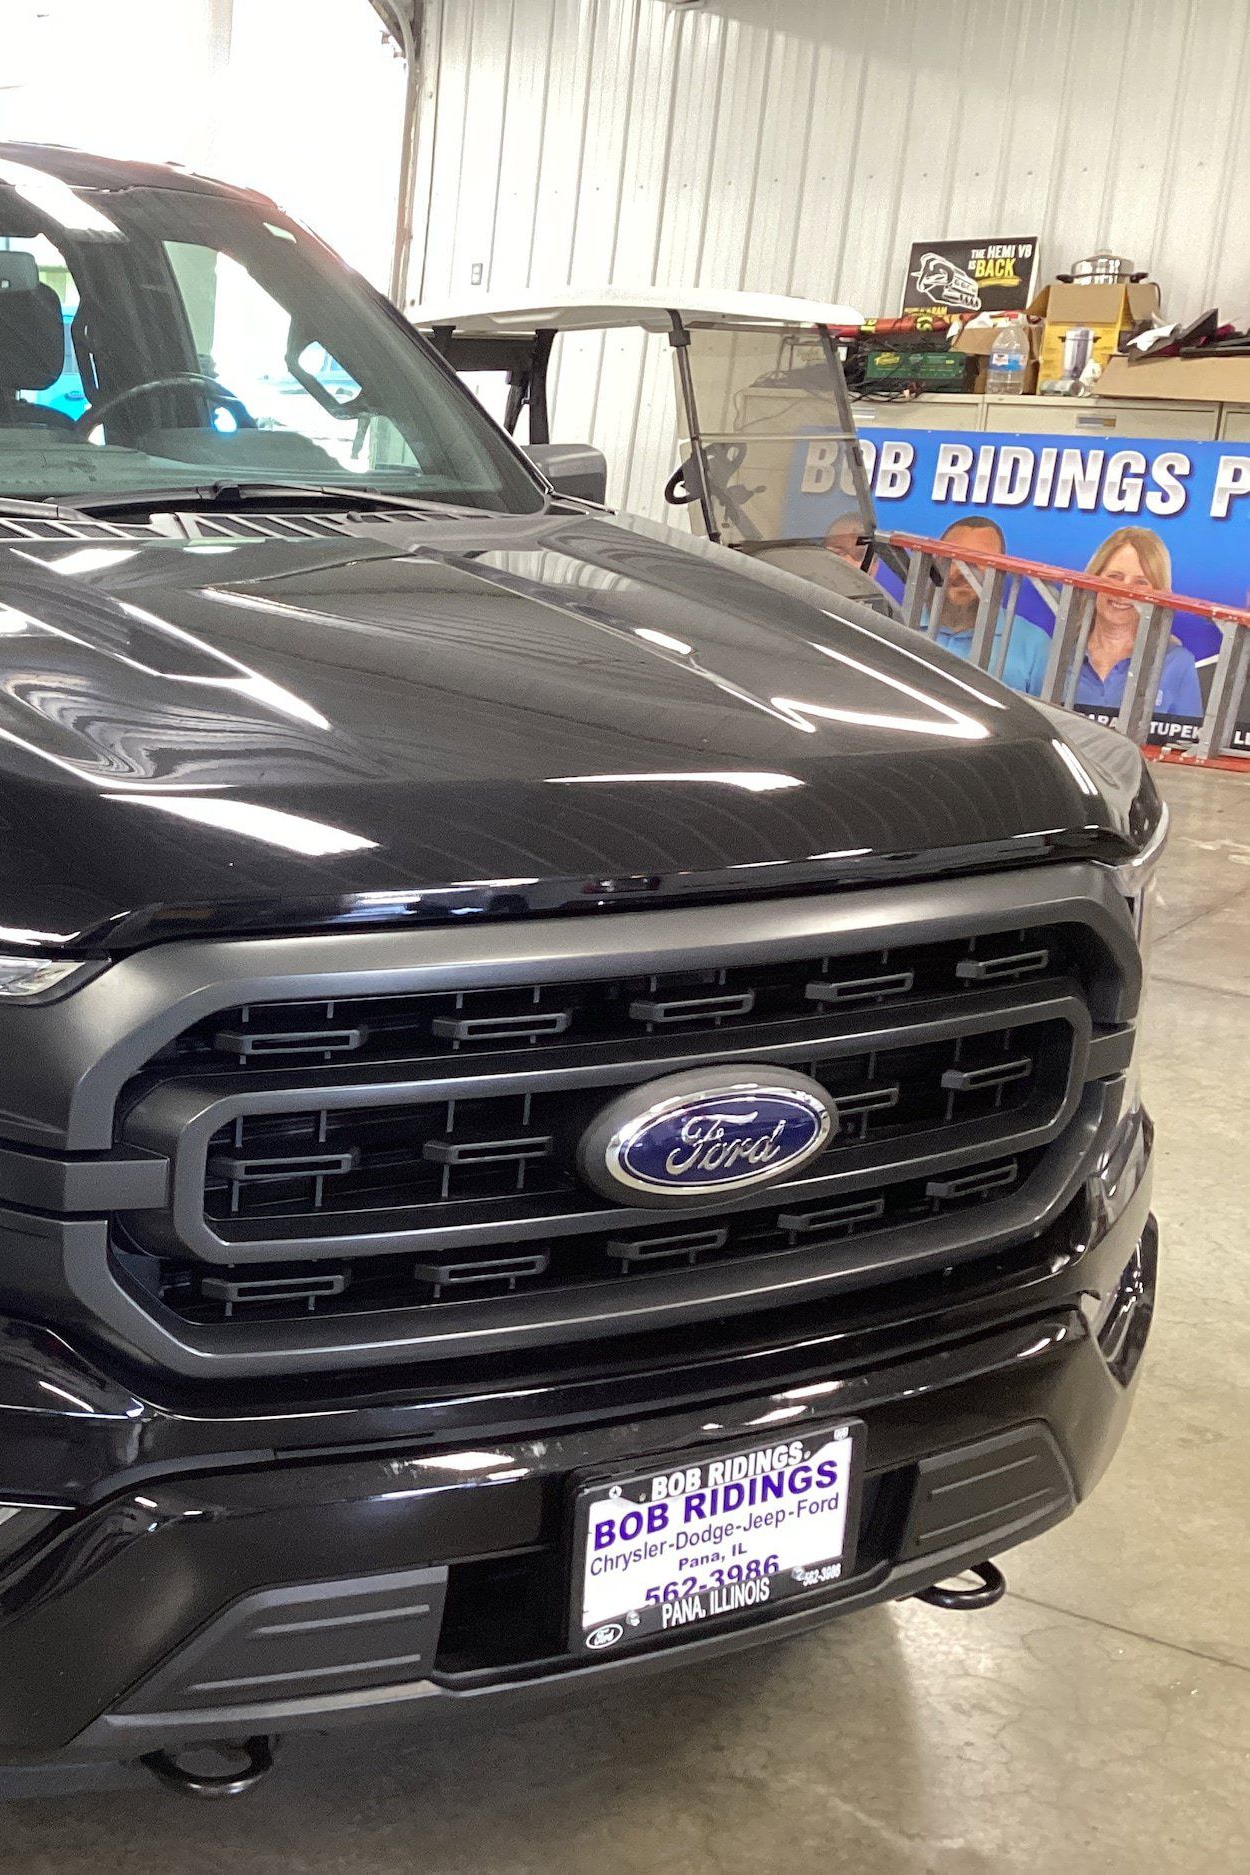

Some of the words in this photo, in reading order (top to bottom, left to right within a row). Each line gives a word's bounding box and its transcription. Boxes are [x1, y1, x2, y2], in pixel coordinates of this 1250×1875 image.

[971, 248, 986, 259] THE
[987, 245, 1016, 259] HEMI
[1018, 244, 1032, 258] V8
[975, 258, 1016, 277] BACK
[931, 443, 1191, 515] RIDINGS
[665, 1111, 787, 1175] Ford
[651, 1467, 702, 1501] BOB
[593, 1502, 669, 1551] BOB
[683, 1460, 838, 1524] RIDINGS
[678, 1552, 725, 1571] Pana,
[732, 1543, 748, 1557] IL
[645, 1554, 779, 1605] 562-3986
[710, 1577, 770, 1616] ILLINOIS
